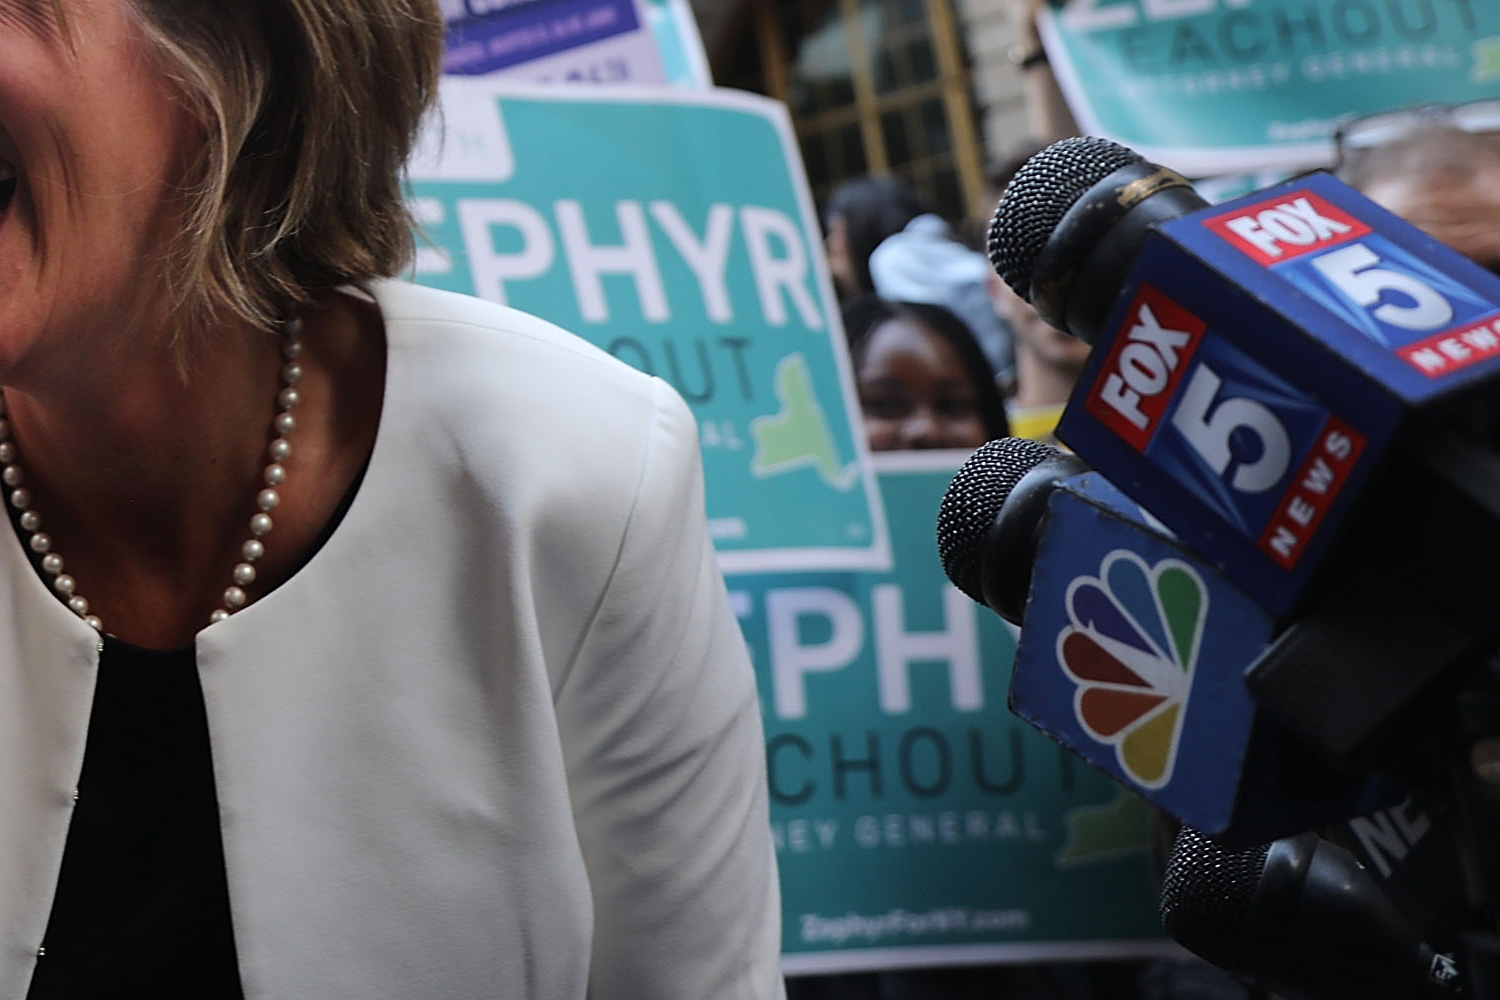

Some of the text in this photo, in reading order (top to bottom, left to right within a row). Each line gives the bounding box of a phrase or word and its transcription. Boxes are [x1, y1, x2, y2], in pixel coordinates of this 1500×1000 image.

[412, 197, 826, 331] PHYR
[1225, 197, 1352, 257] FOX
[1311, 243, 1453, 330] 5
[1100, 303, 1191, 431] FOX
[1171, 362, 1291, 494] 5
[1269, 431, 1352, 558] NEWS
[855, 811, 1047, 849] GENERAL
